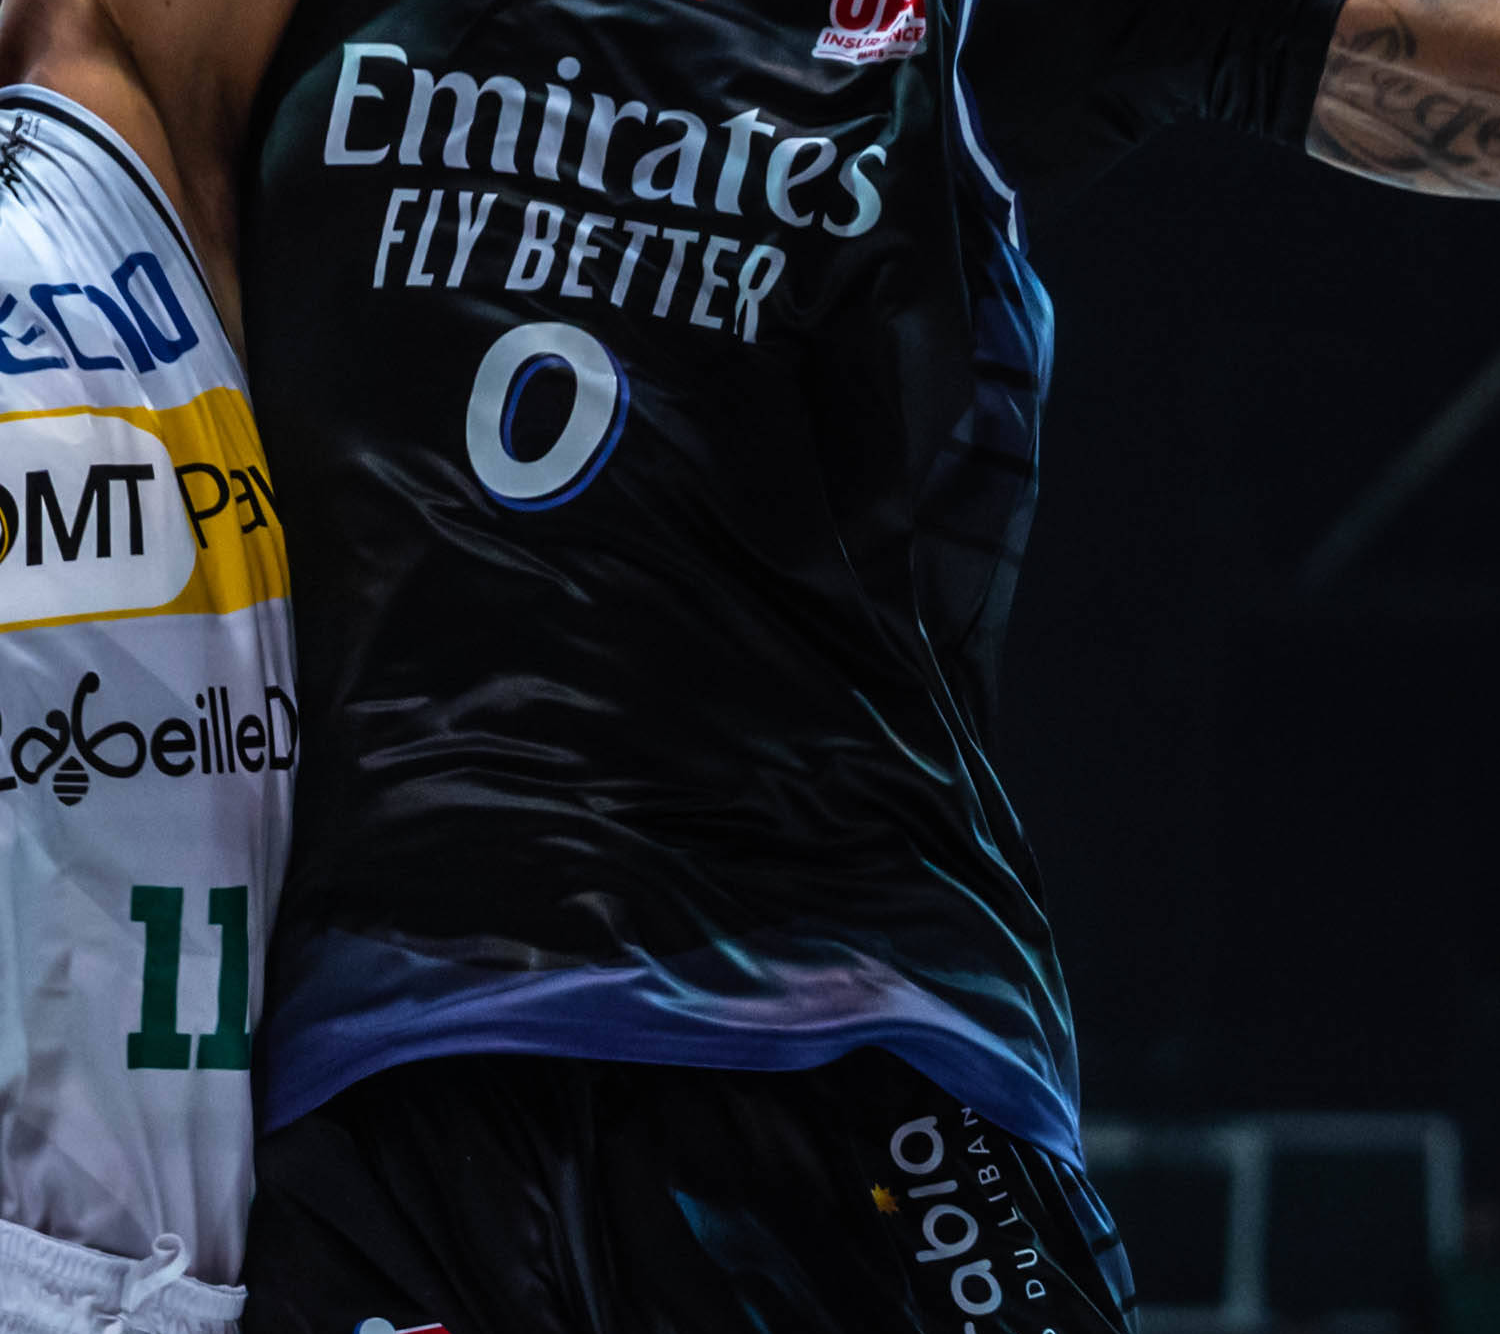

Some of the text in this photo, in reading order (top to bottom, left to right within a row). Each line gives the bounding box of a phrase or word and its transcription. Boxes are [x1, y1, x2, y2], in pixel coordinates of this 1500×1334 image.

[321, 41, 889, 239] Emirates
[372, 188, 787, 344] FLY BETTER
[466, 321, 630, 512] 0
[127, 884, 251, 1071] 11
[960, 1106, 1019, 1228] LIBAN
[1014, 1245, 1048, 1301] DU
